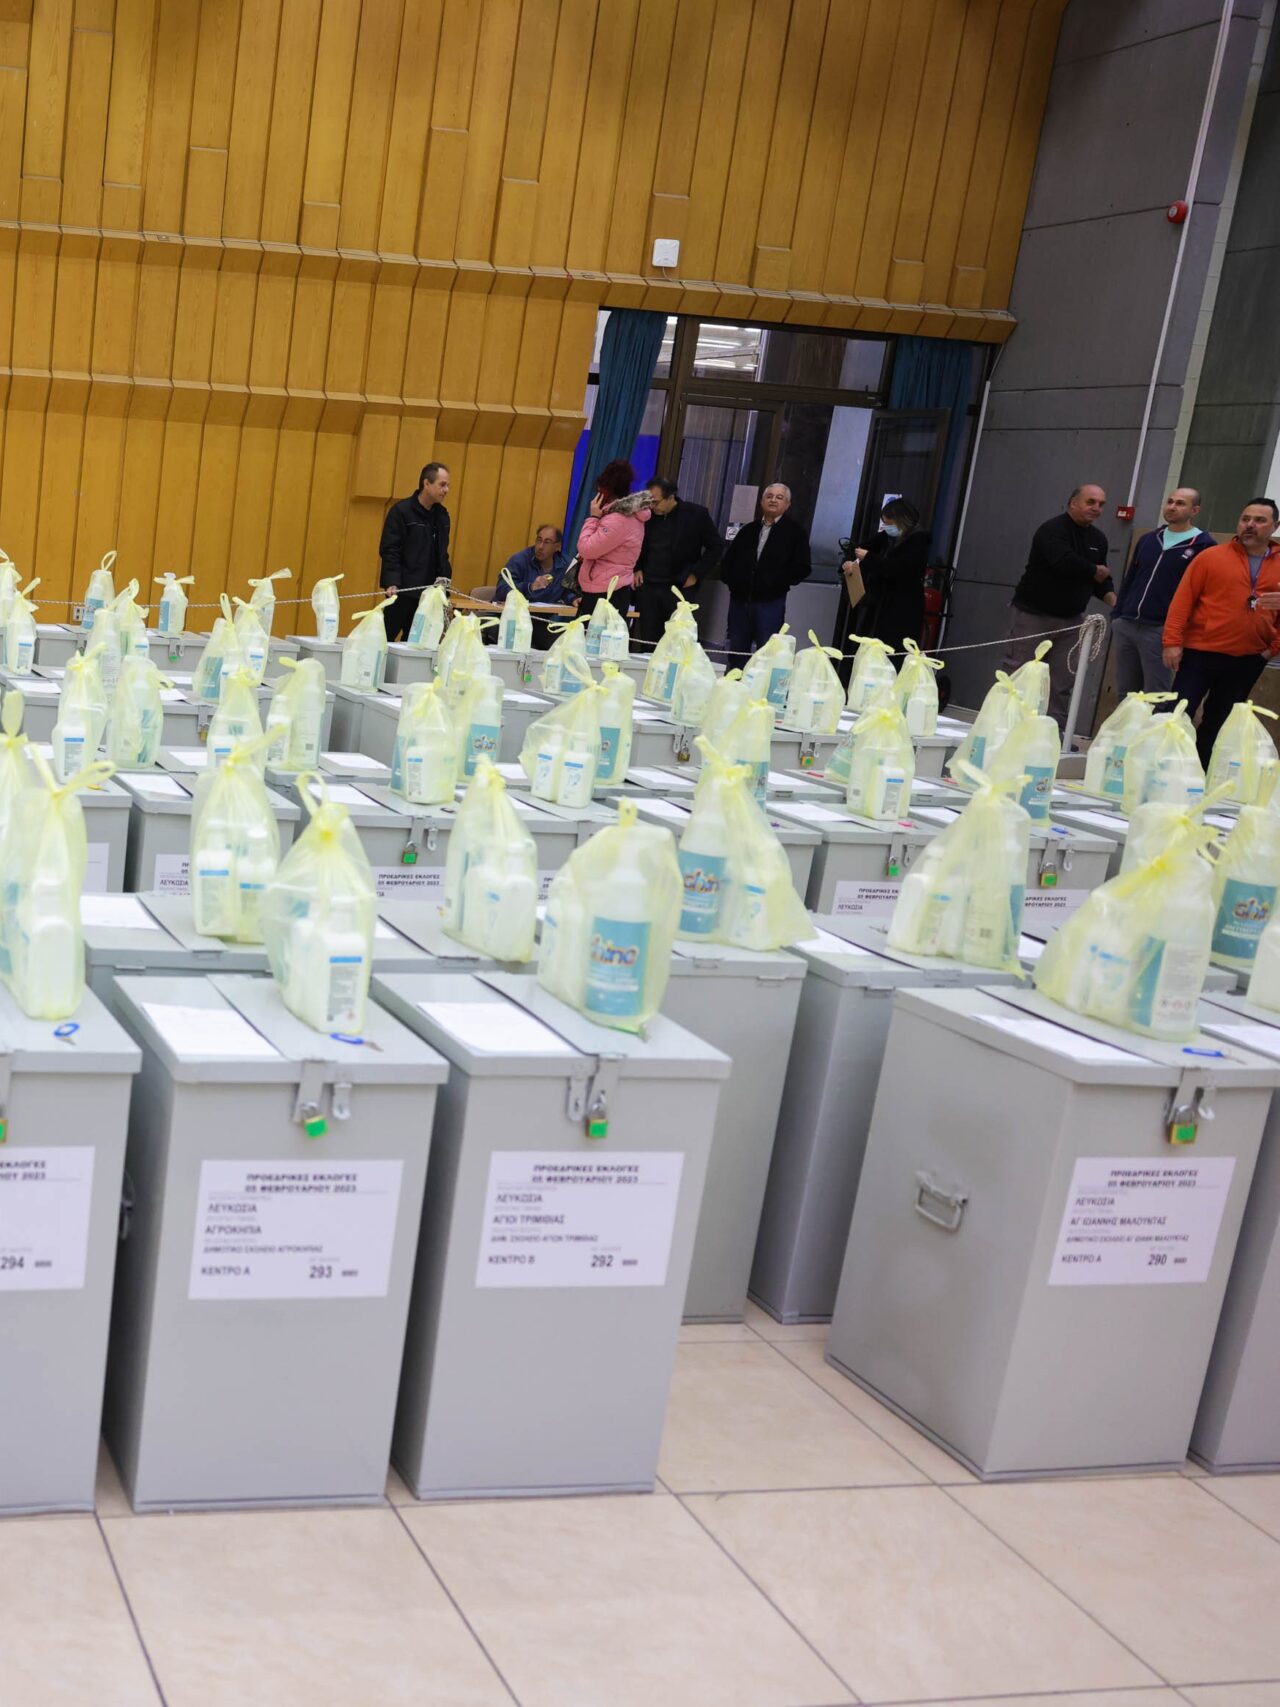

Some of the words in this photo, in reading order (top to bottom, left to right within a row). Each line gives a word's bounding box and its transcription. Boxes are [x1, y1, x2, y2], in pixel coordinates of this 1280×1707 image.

[0, 1256, 25, 1270] 294
[591, 1254, 615, 1268] 292
[1147, 1253, 1167, 1266] 290
[309, 1265, 333, 1279] 293
